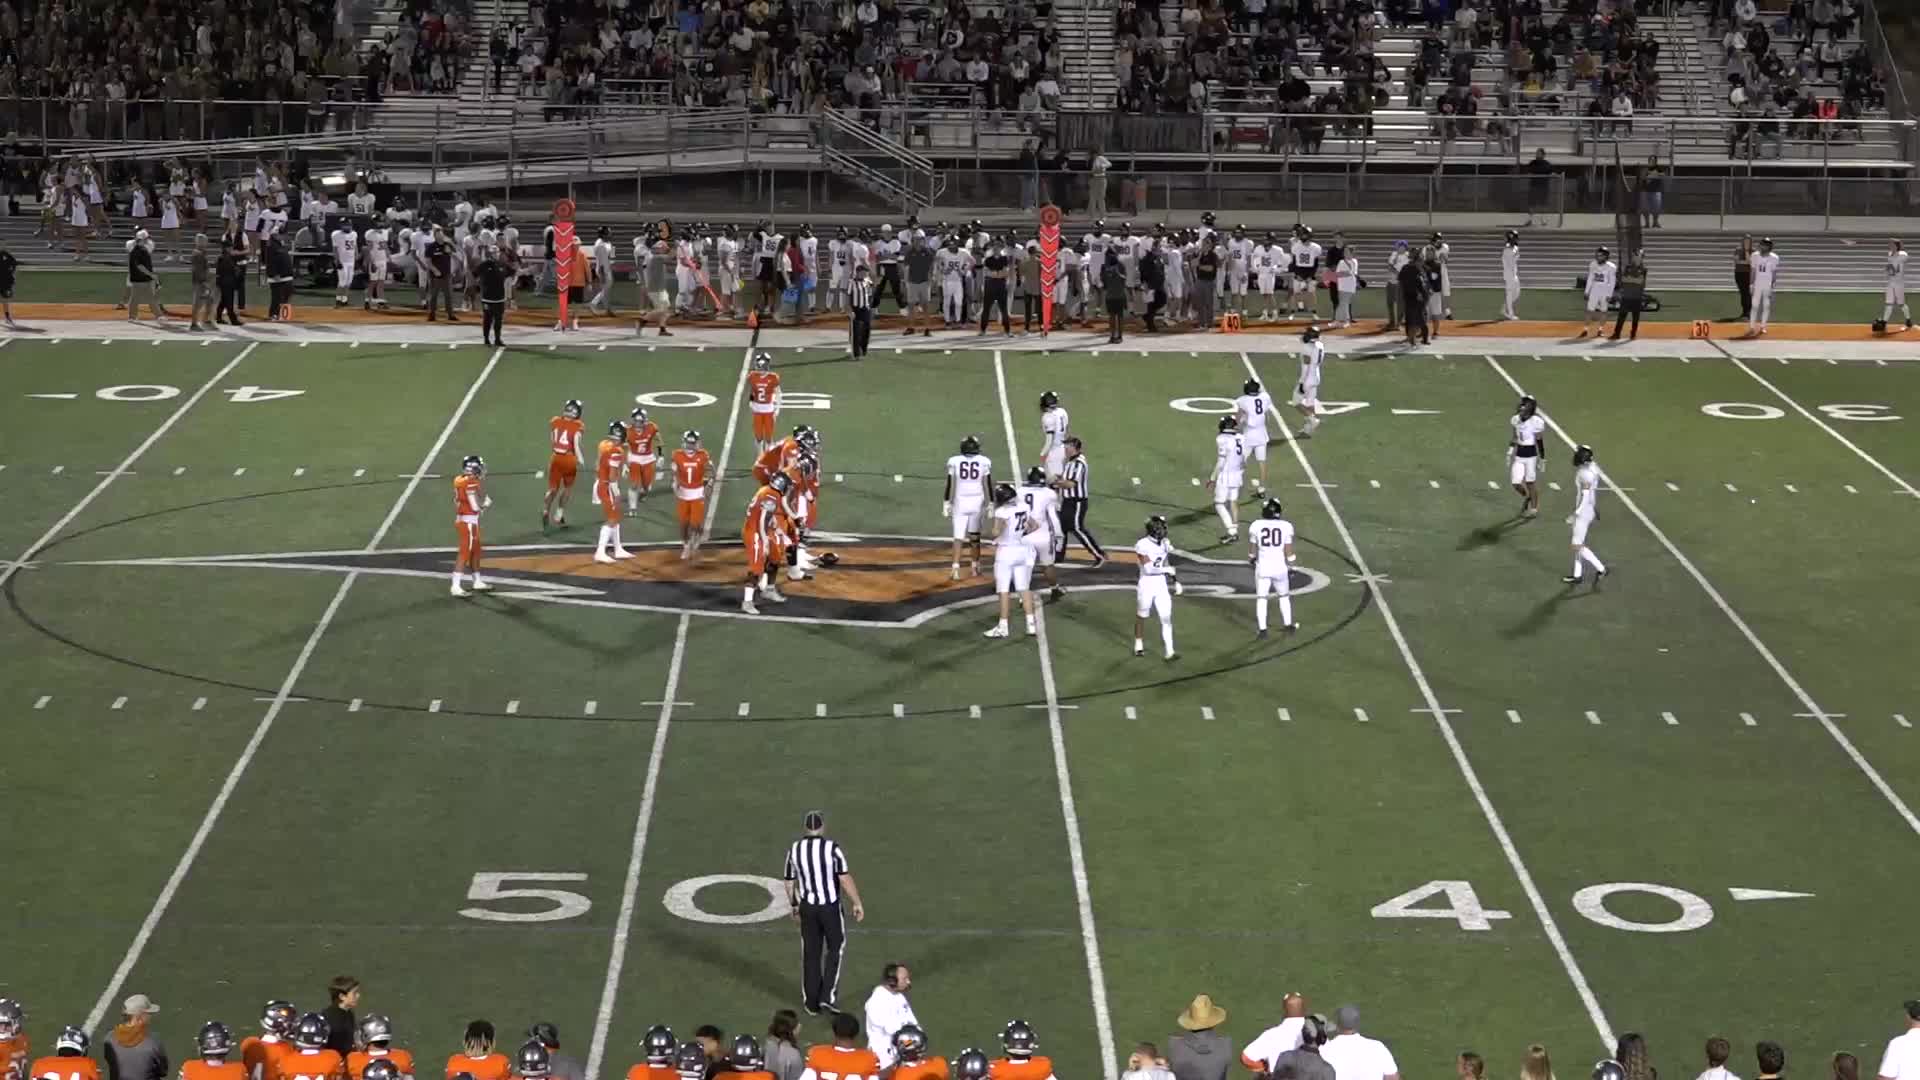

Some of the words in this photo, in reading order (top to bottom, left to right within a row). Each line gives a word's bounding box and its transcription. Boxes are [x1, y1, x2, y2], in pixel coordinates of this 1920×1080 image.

[758, 389, 767, 402] 2
[1254, 398, 1264, 415] 8
[553, 428, 570, 446] 14
[1235, 438, 1244, 456] 5
[959, 460, 981, 481] 66
[1024, 492, 1034, 512] 9
[1260, 527, 1283, 548] 20
